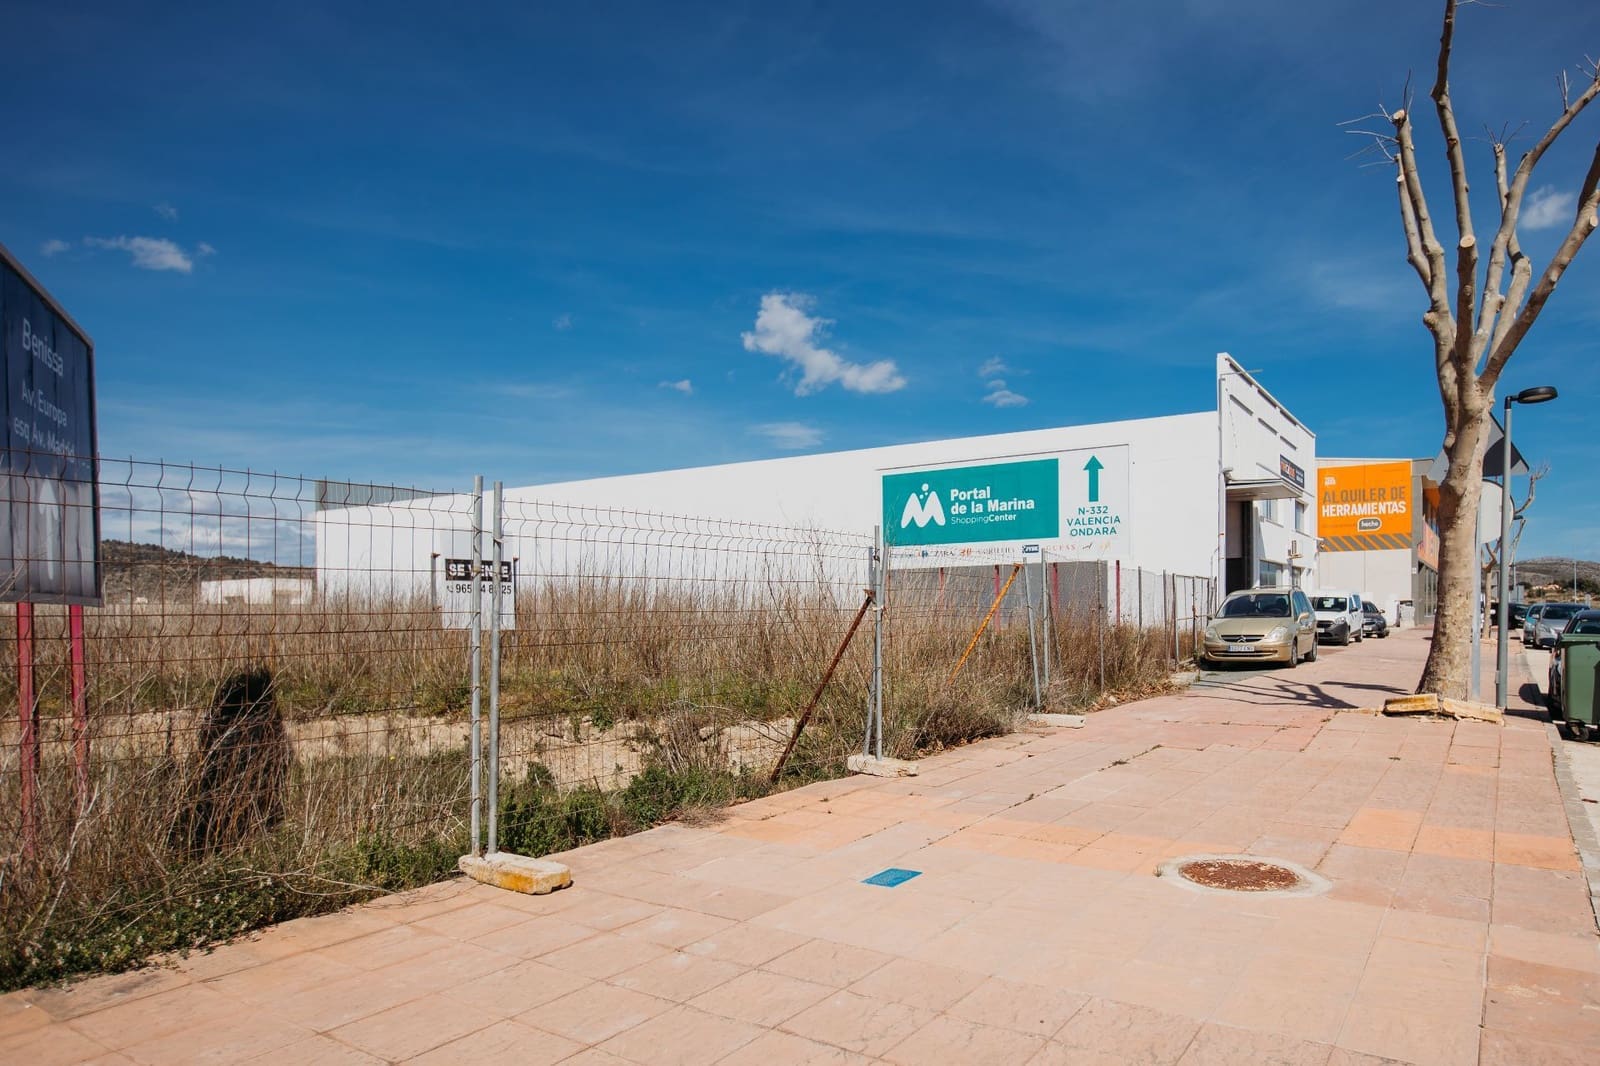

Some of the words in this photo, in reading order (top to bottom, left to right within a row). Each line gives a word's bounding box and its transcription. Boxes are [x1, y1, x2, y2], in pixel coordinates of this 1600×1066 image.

[22, 317, 64, 377] Benissa
[22, 379, 37, 408] Av.
[38, 389, 67, 427] Europa
[950, 486, 991, 502] Portal
[1323, 487, 1386, 505] ALQUILER
[1391, 486, 1406, 501] DE
[951, 502, 967, 515] de
[971, 501, 983, 514] la
[987, 498, 1035, 512] Marina
[1078, 505, 1109, 516] N-332
[1322, 501, 1407, 518] HERRAMIENTAS
[951, 513, 1017, 525] ShoppingCenter
[1066, 515, 1121, 527] VALENCIA
[1070, 526, 1118, 537] ONDARA
[448, 563, 466, 577] SE
[468, 564, 509, 579] ENE
[455, 583, 473, 594] 965
[501, 585, 512, 595] 25
